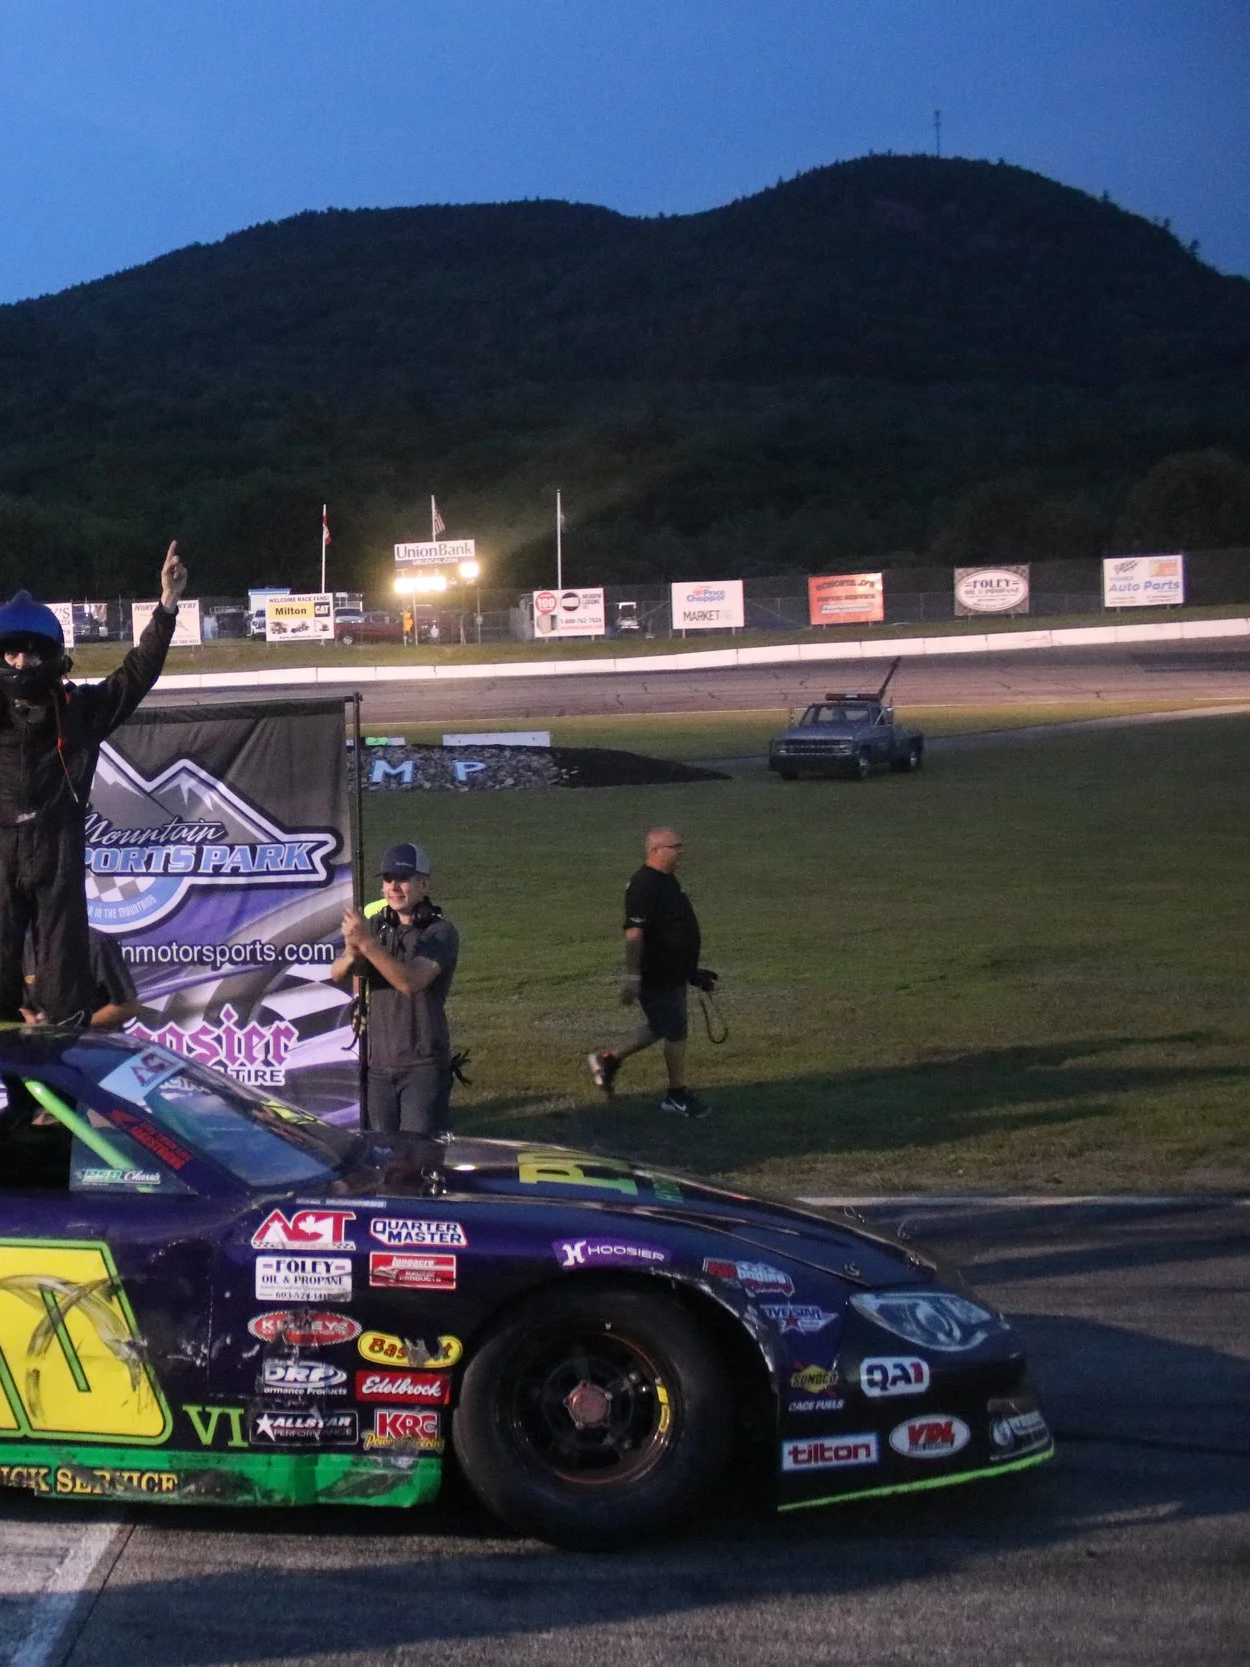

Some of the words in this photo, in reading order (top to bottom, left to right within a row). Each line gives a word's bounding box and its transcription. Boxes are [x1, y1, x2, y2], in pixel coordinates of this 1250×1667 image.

[973, 579, 1010, 589] FOLEY
[1109, 583, 1140, 592] Auto
[1144, 580, 1180, 590] Parts
[315, 605, 330, 614] CAT
[683, 610, 720, 621] MARKET
[200, 842, 318, 874] PARK
[253, 1210, 355, 1244] ACT
[373, 1221, 458, 1234] QUARTER
[387, 1231, 462, 1244] MASTER
[588, 1245, 666, 1262] HOOSIER
[275, 1260, 334, 1274] FOLEY
[262, 1275, 277, 1284] OIL
[283, 1275, 291, 1284] &
[294, 1275, 343, 1286] PROPANE
[866, 1361, 924, 1392] QA1
[361, 1376, 442, 1397] Edelbrock
[182, 1405, 249, 1448] VI
[376, 1411, 438, 1441] KRC
[788, 1443, 871, 1465] tilton
